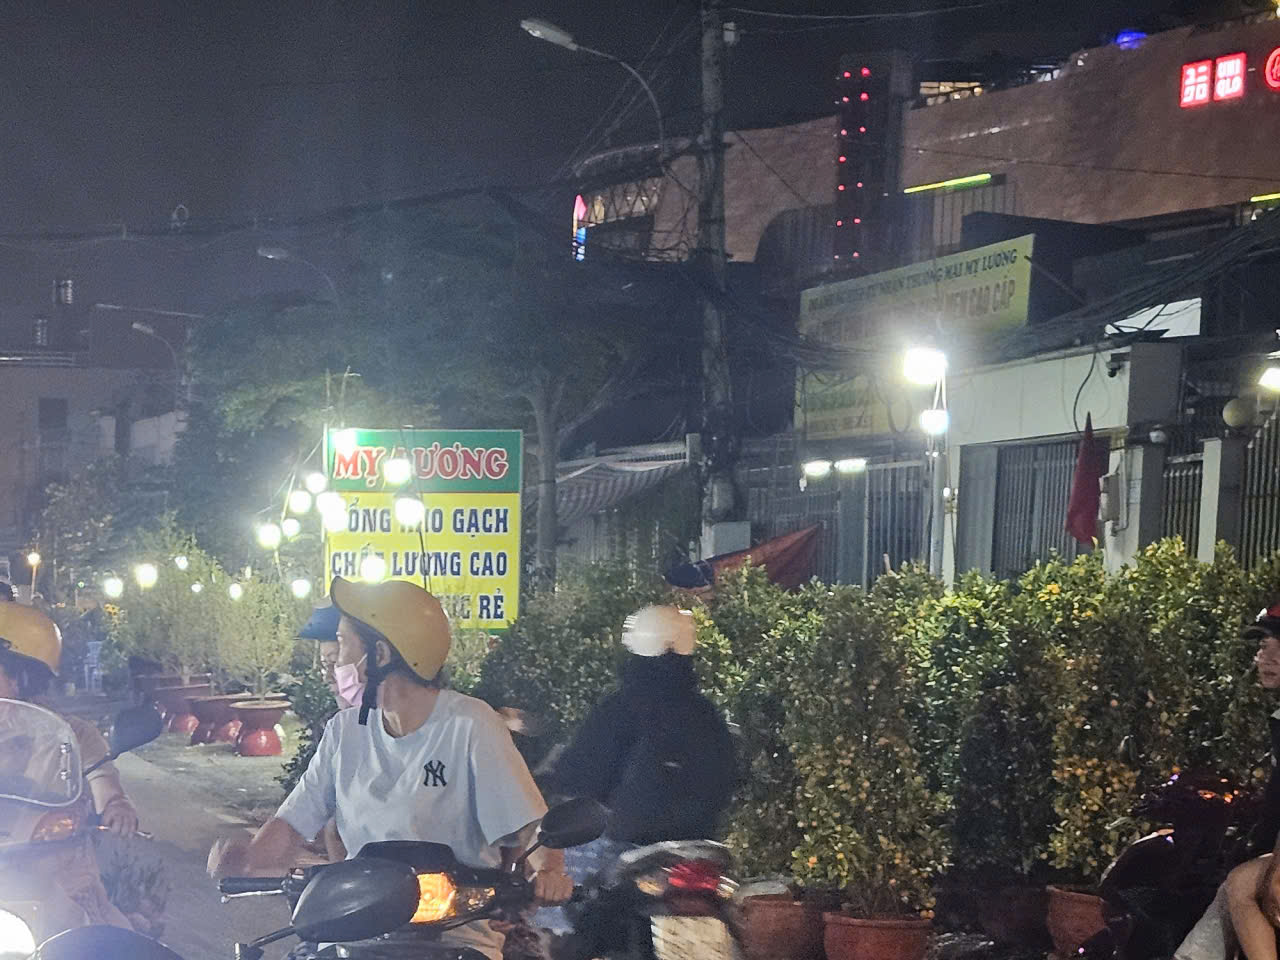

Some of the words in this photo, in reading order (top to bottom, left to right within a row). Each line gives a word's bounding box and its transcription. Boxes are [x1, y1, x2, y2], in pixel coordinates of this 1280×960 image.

[394, 442, 510, 480] ƯƠNG
[453, 507, 509, 538] GẠCH
[470, 551, 508, 577] CAO
[479, 587, 505, 620] RẺ
[423, 759, 448, 788] NY
